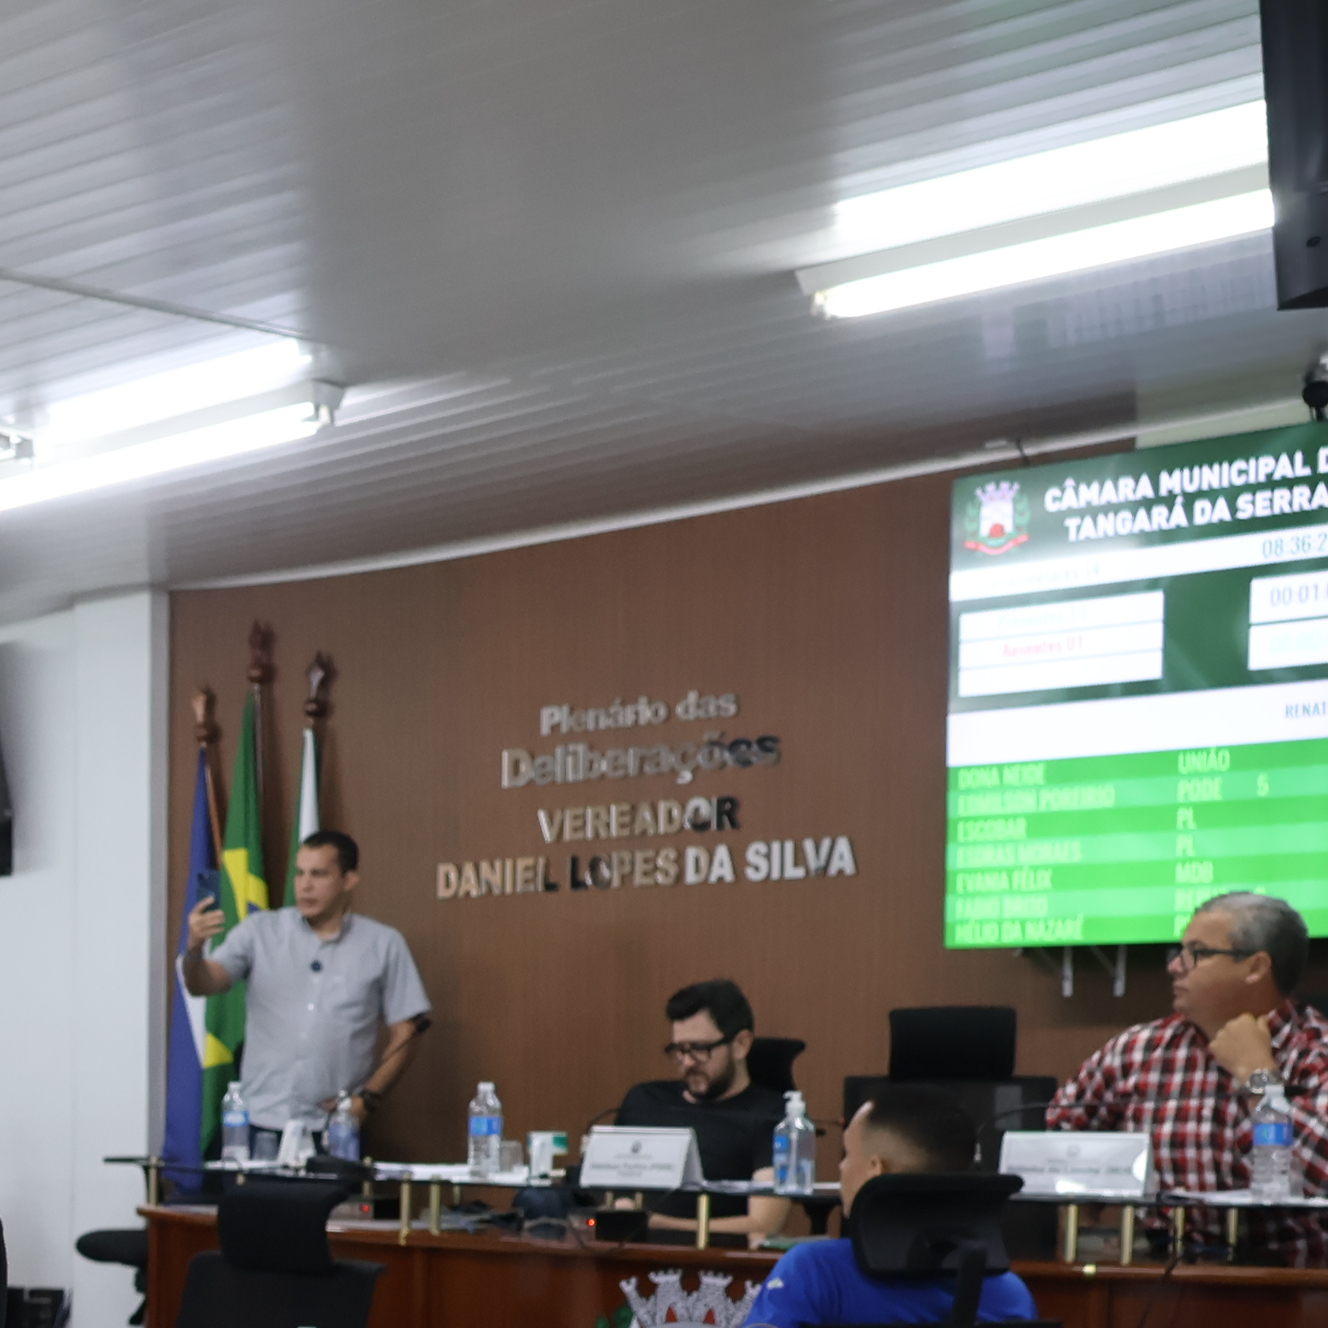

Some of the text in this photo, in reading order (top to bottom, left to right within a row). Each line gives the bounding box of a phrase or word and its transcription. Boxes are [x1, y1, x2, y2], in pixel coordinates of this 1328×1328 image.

[1044, 476, 1155, 513] CÂMARA
[1158, 449, 1313, 497] MUNICIPAL
[1063, 480, 1328, 543] TANGARÁ DA SERRA
[539, 689, 738, 737] Plenário das
[500, 732, 782, 789] Deliberações
[1177, 745, 1231, 775] UNIÃO
[1176, 776, 1223, 803] PODE
[537, 795, 741, 844] VEREADOR
[956, 806, 1197, 843] ESCOBAR PL
[437, 835, 858, 899] DANIEL LOPES DA SILVA
[1175, 833, 1196, 857] PL
[1175, 860, 1214, 885] MDB
